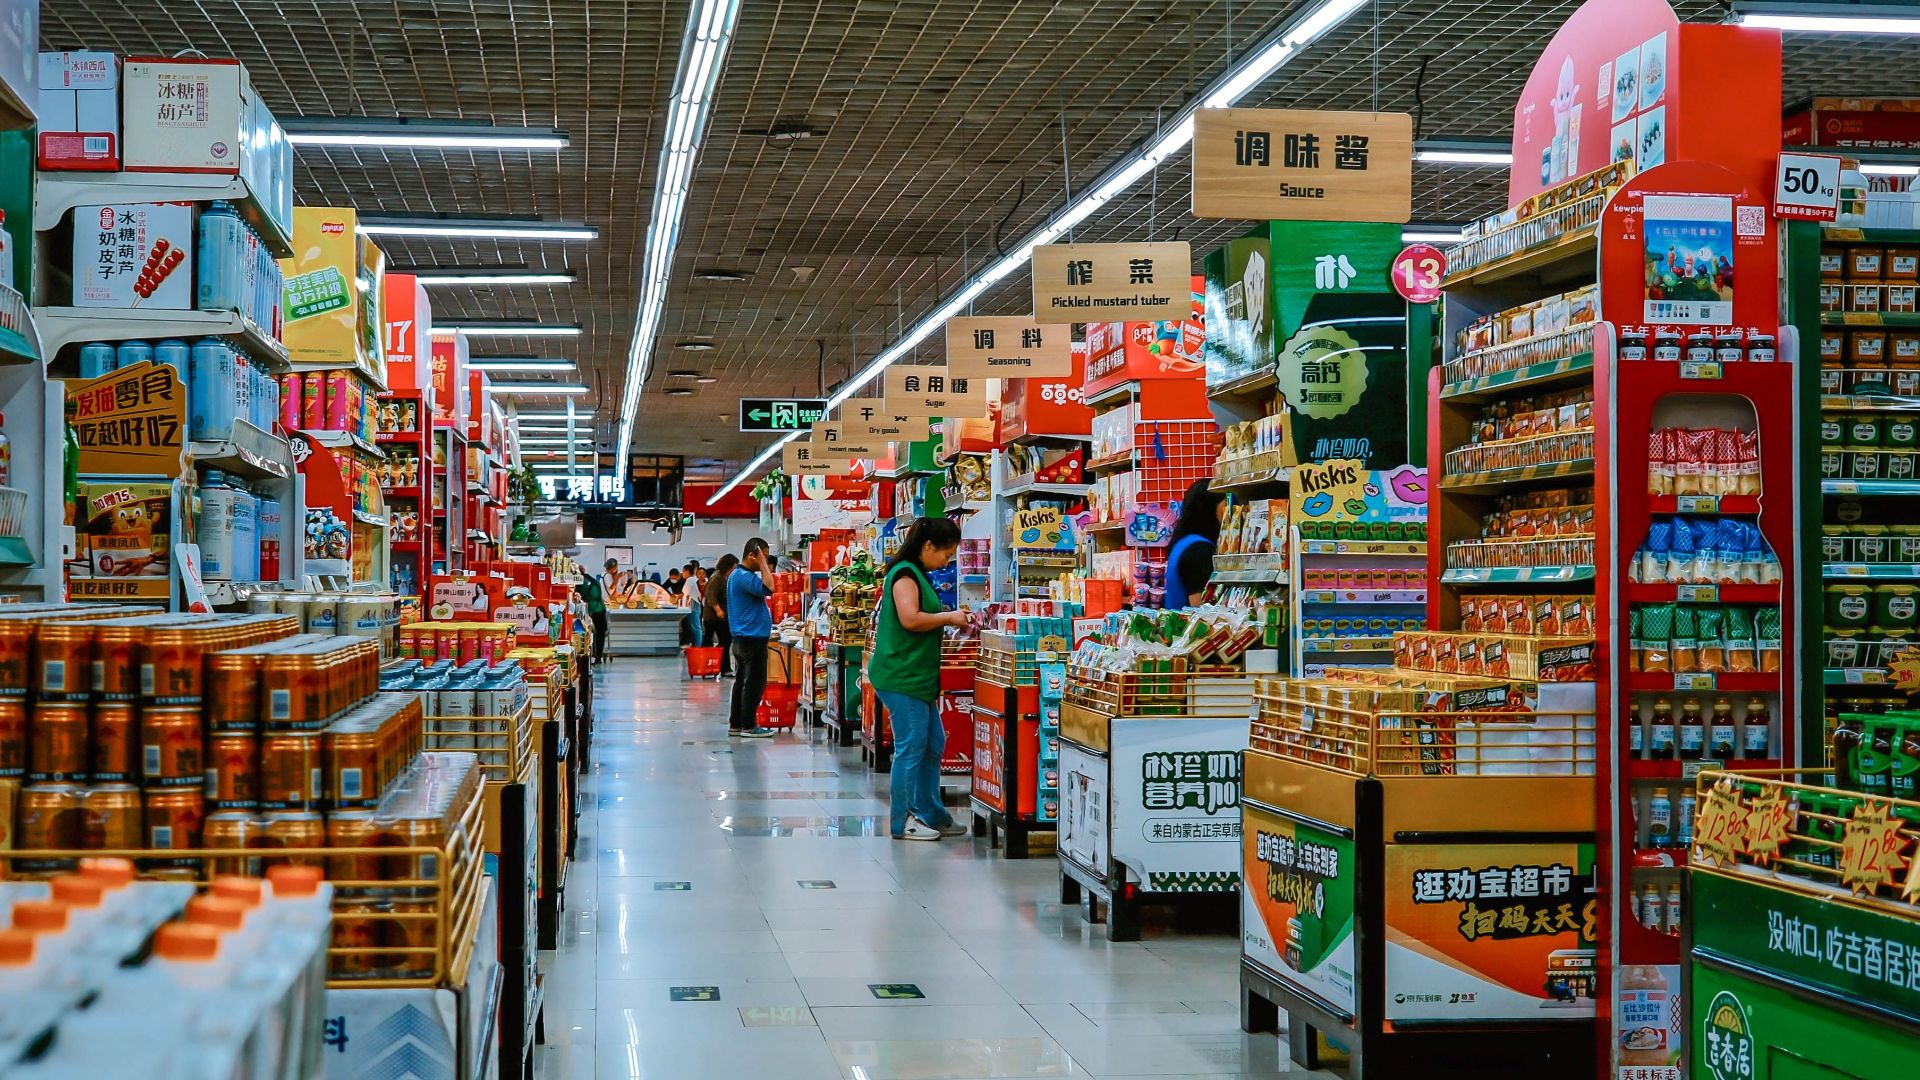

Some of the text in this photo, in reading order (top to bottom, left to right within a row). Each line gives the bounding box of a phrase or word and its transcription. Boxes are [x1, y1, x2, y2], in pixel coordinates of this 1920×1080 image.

[158, 82, 195, 100] 冰糖
[158, 103, 195, 121] 葫芦
[1235, 130, 1370, 170] 调味酱
[1280, 182, 1325, 200] Sauce
[1783, 167, 1834, 197] 50 kg
[100, 207, 115, 230] 金星
[1613, 203, 1643, 214] kewpie
[118, 210, 136, 275] 冰糖葫芦
[98, 232, 117, 280] 奶皮子
[1067, 258, 1155, 286] 榨菜
[1398, 258, 1441, 289] 13
[1051, 294, 1171, 308] Pickled mustard tuber
[974, 328, 1043, 350] 调料
[987, 357, 1031, 367] Seasoning
[1301, 361, 1341, 384] 高钙
[904, 375, 968, 394] 食用糖
[925, 399, 946, 408] Sugar
[869, 427, 900, 436] Dry goods
[827, 445, 846, 453] Instant
[1299, 464, 1358, 495] Kiskis
[1019, 509, 1056, 529] Kiskis
[71, 583, 139, 595] 越吃越好吃
[1145, 753, 1241, 780] 朴珍奶
[1145, 781, 1241, 815] 营养加
[1153, 823, 1241, 839] 来自内蒙古正宗草原
[1257, 832, 1338, 879] 逛劝宝超市 上京东到家
[1415, 865, 1572, 902] 逛劝宝超市
[1406, 994, 1443, 1003] 京东到家
[1622, 1003, 1661, 1015] 丘比沙拉汁
[1707, 1024, 1751, 1075] 吉香居
[1622, 1068, 1677, 1080] 美味标志
